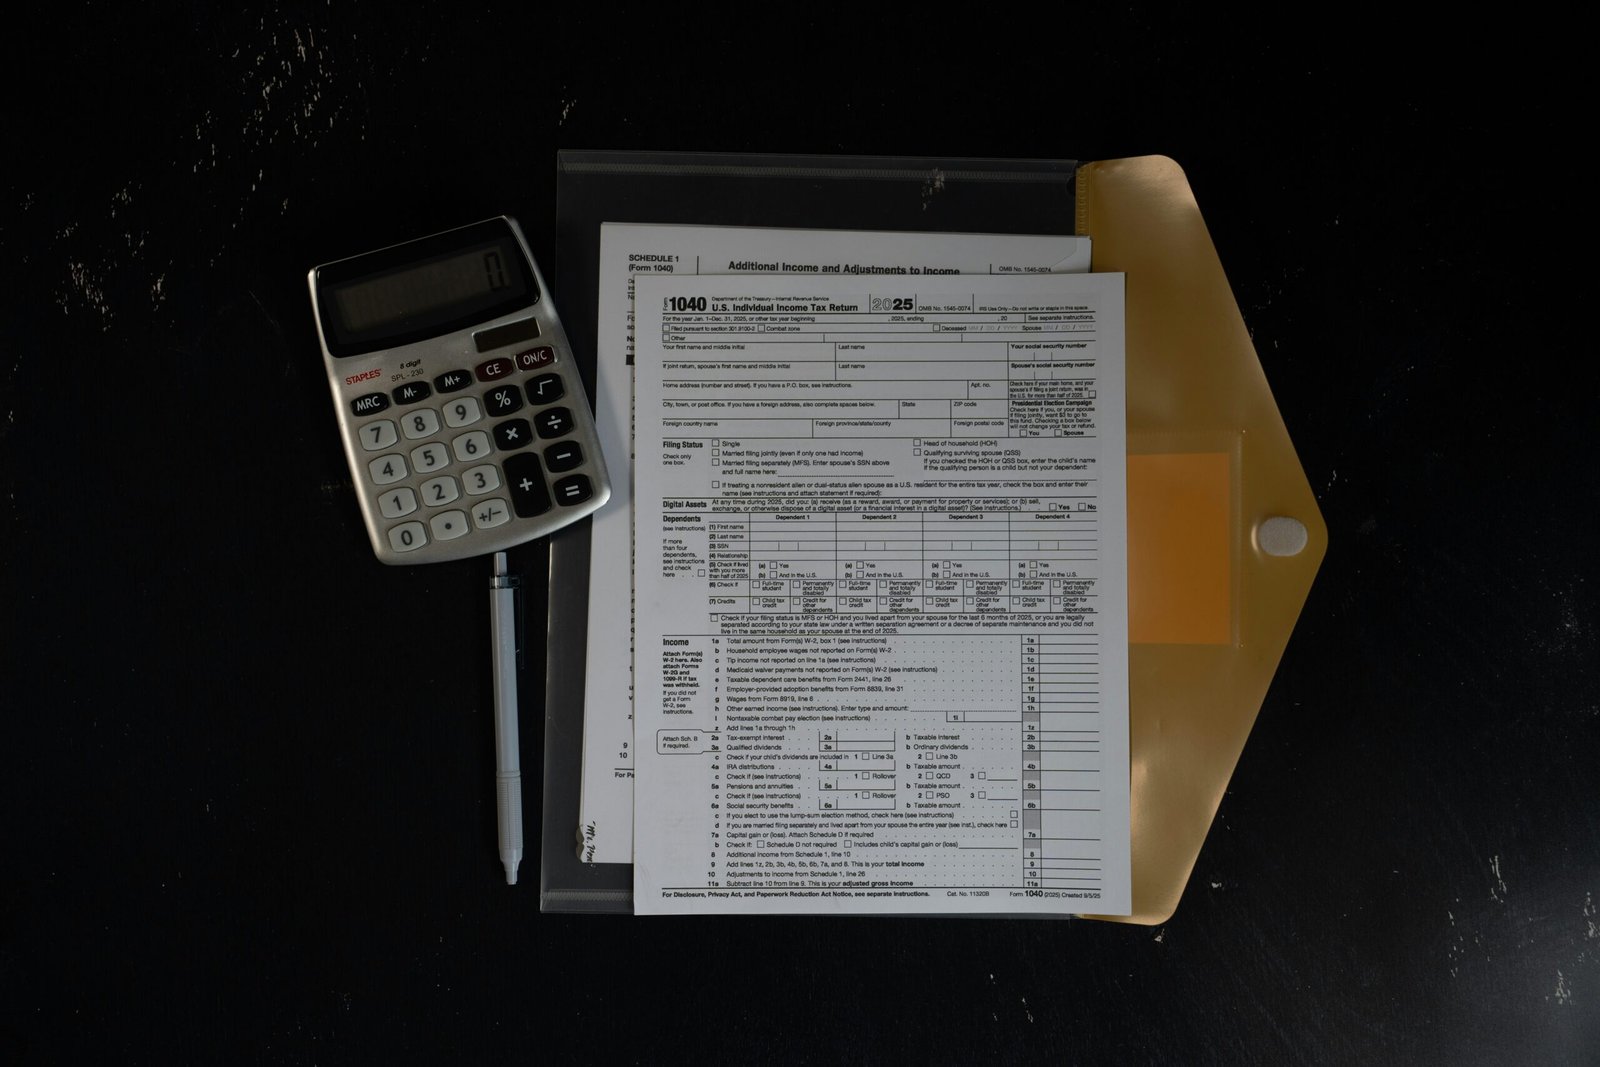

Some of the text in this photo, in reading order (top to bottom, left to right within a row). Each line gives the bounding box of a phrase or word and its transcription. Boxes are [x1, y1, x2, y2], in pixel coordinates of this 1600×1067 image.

[629, 254, 673, 262] SCHEDULE
[484, 252, 506, 291] 0
[629, 264, 673, 273] (Form 1040)
[728, 261, 779, 271] Additional
[782, 263, 819, 272] Income
[822, 264, 840, 273] and
[843, 265, 906, 274] Adjustments
[670, 297, 706, 312] 1040
[733, 304, 774, 312] Individual
[810, 304, 826, 312] Tax
[872, 298, 914, 311] 2025
[406, 359, 421, 368] digit
[523, 350, 547, 365] ON/C
[346, 369, 381, 385] STAPLES
[392, 372, 404, 382] SPL
[411, 368, 424, 378] 230
[486, 363, 501, 376] CE
[445, 375, 460, 387] M+
[357, 396, 381, 411] MRC
[495, 390, 511, 407] %
[456, 405, 466, 421] 9
[413, 416, 426, 432] 8
[370, 426, 382, 443] 7
[465, 439, 477, 454] 6
[423, 450, 435, 466] 5
[382, 461, 394, 476] 4
[474, 472, 486, 488] 3
[433, 484, 446, 500] 2
[393, 496, 402, 511] 1
[401, 530, 412, 546] 0
